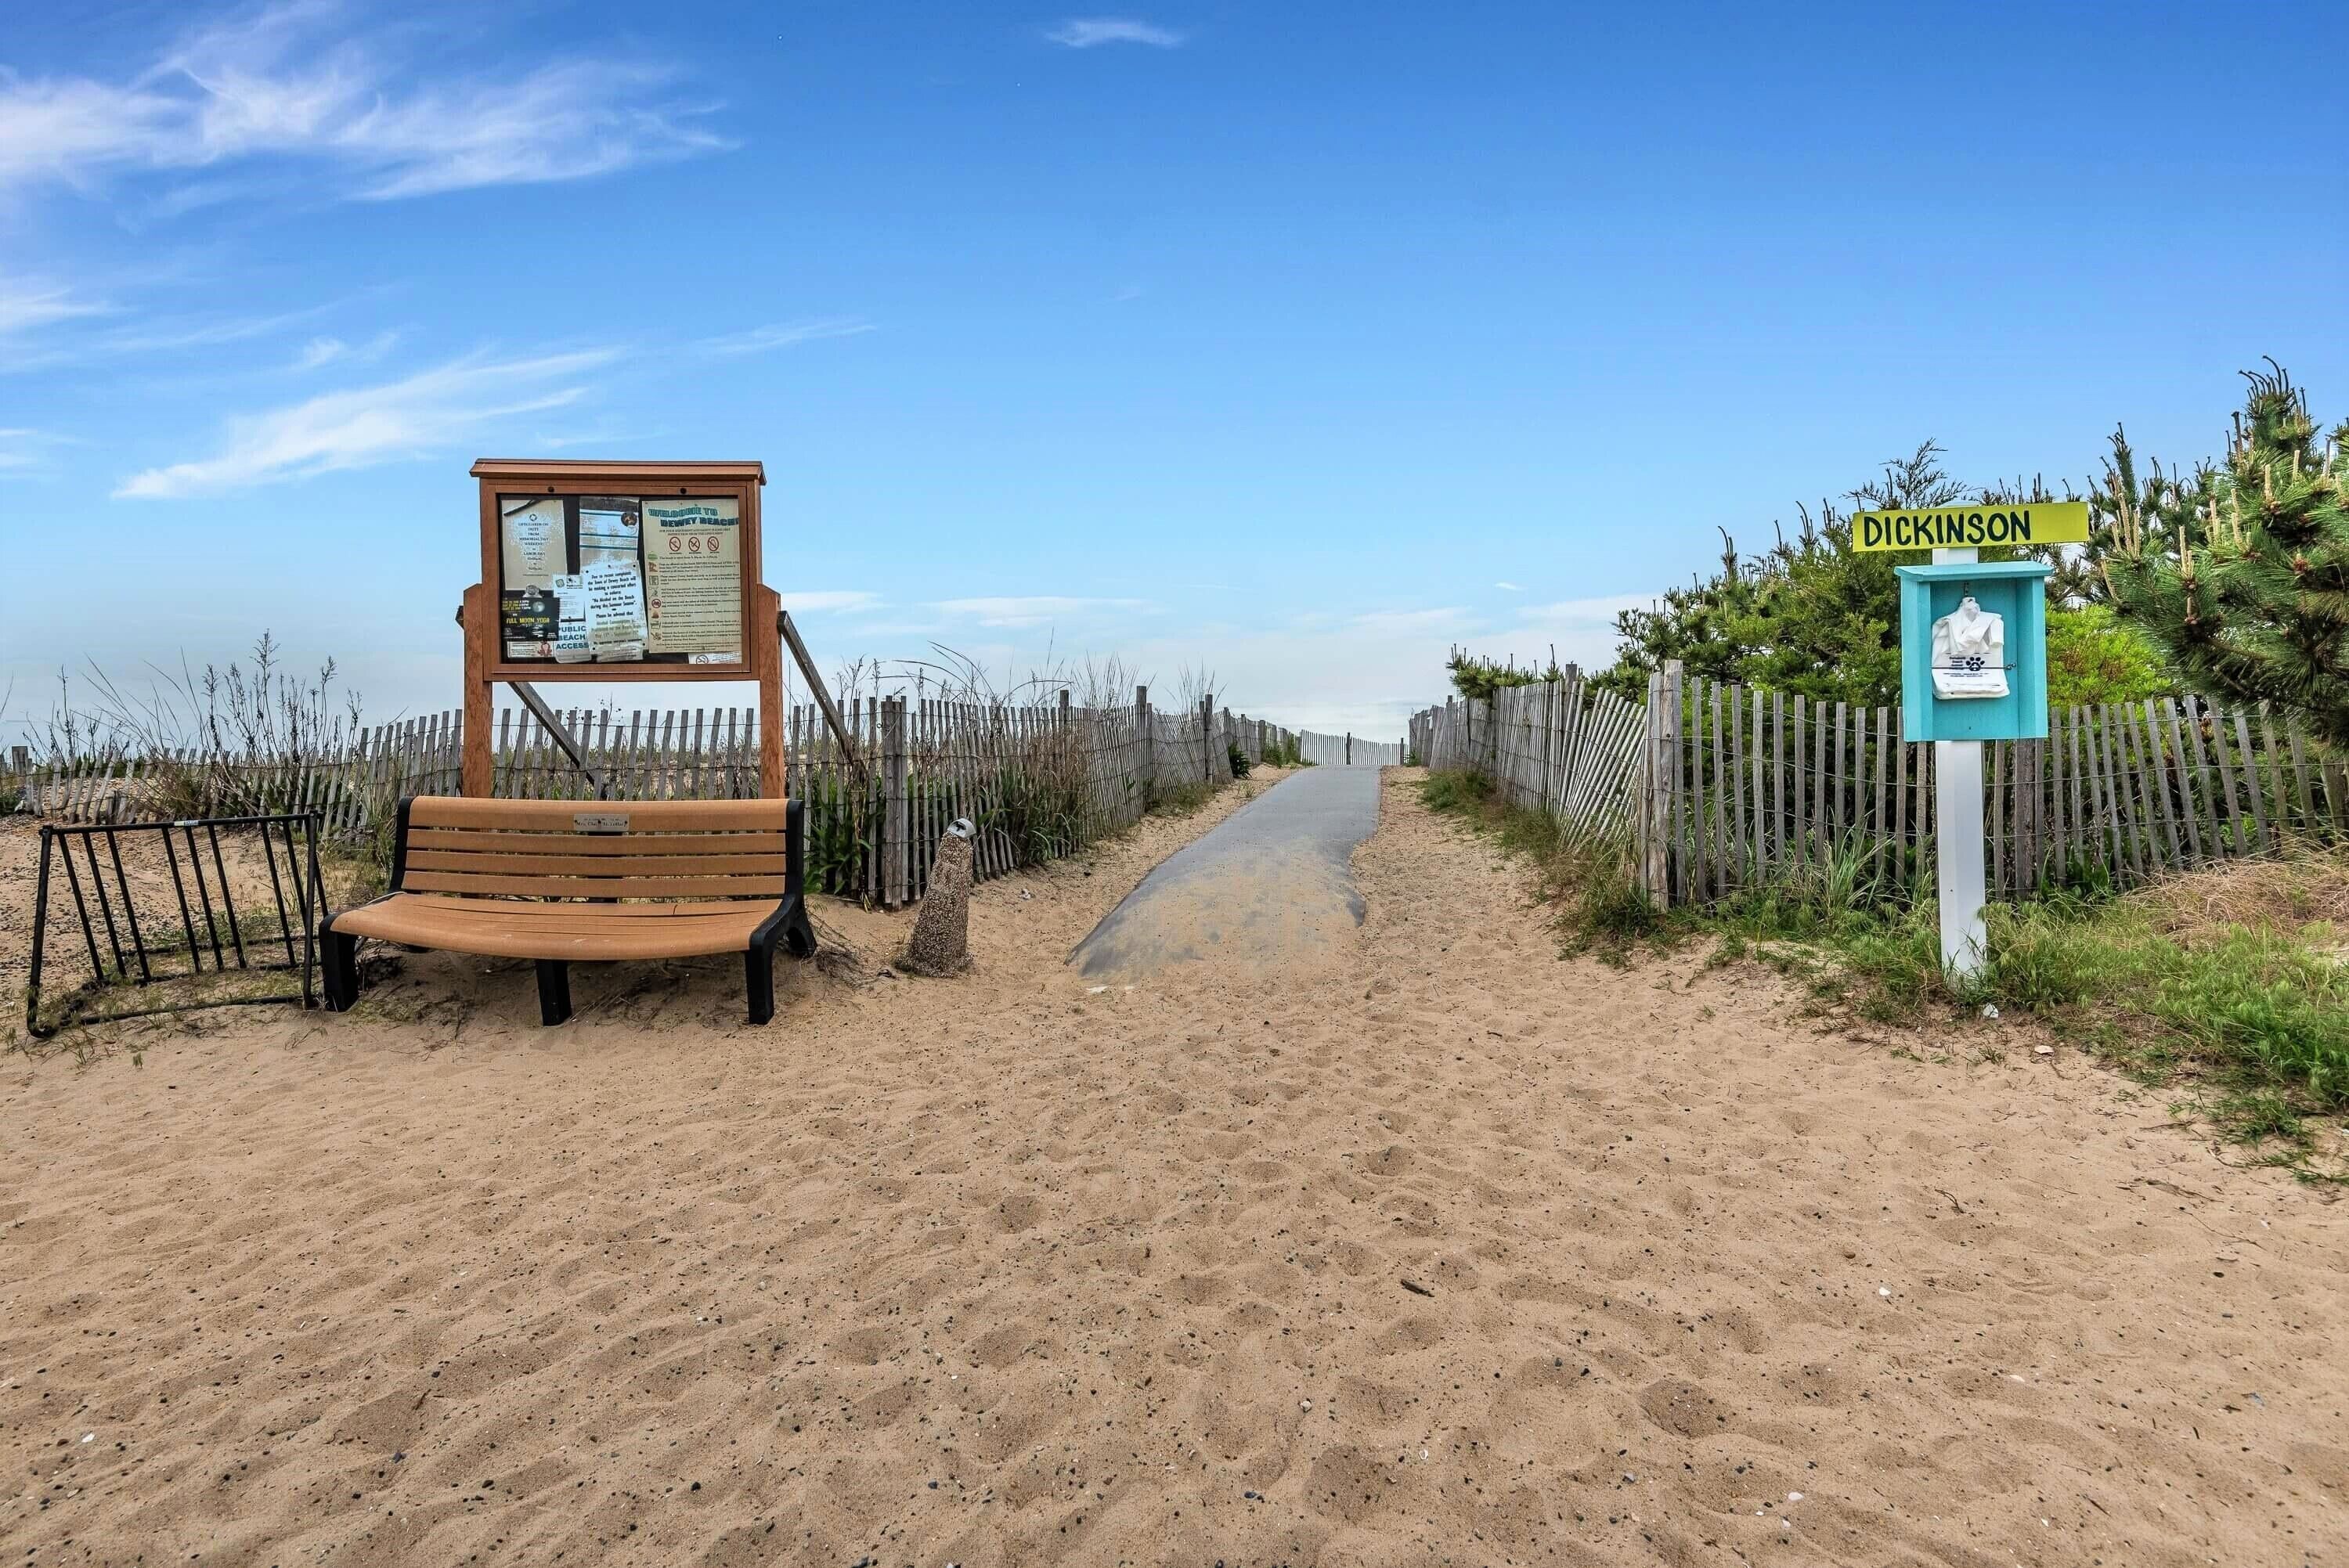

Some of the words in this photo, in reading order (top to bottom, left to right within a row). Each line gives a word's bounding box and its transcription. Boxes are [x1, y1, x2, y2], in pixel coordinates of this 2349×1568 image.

[648, 507, 702, 517] WELCOME
[660, 517, 698, 527] DEWEY
[1864, 510, 2031, 546] DICKINSON
